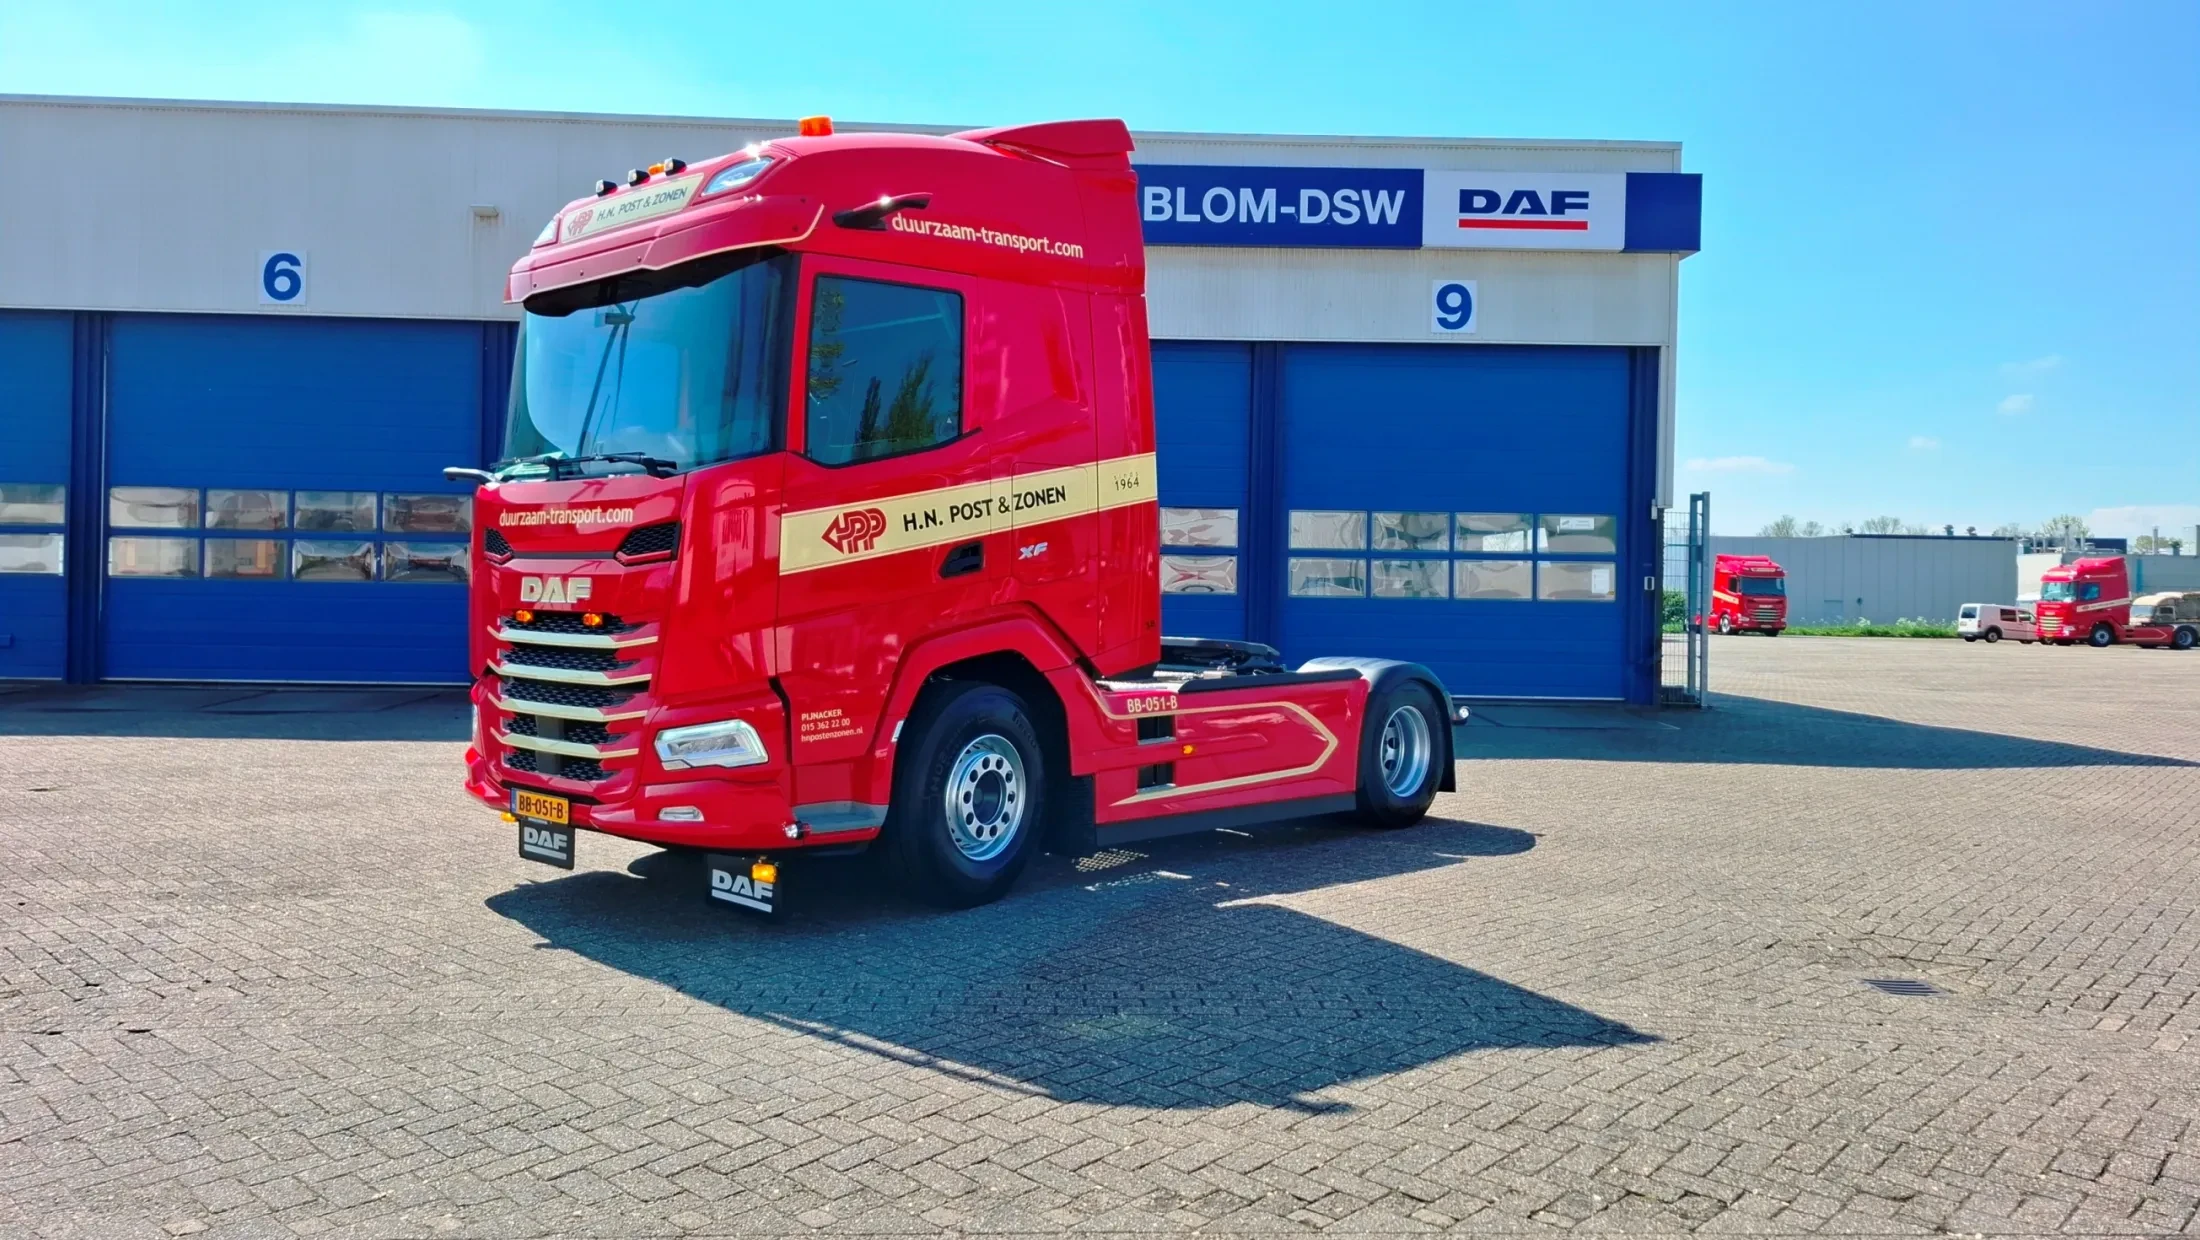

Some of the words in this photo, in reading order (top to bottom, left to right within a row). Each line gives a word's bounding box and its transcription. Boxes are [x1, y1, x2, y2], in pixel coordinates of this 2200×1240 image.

[596, 207, 615, 221] H.N.
[618, 199, 644, 214] POST
[643, 197, 651, 208] &
[652, 187, 688, 205] ZONEN
[1143, 186, 1405, 225] BLOM-DSW
[1459, 189, 1590, 215] DAF
[891, 212, 1084, 259] duurzaam-transport.com
[263, 252, 302, 301] 6
[1436, 283, 1472, 330] 9
[1115, 477, 1139, 491] 1964
[499, 506, 633, 527] duurzaam-transport.com
[903, 509, 943, 532] H.N.
[950, 499, 993, 523] POST
[998, 496, 1010, 514] &
[1013, 485, 1066, 511] ZONEN
[1018, 541, 1048, 561] XF
[520, 576, 592, 604] DAF
[801, 709, 842, 721] PIJNACKER
[1127, 695, 1178, 713] BB-051-B
[801, 723, 815, 732] 015
[816, 720, 830, 730] 362
[831, 719, 840, 728] 22
[841, 718, 851, 726] 00
[801, 726, 863, 742] hnpostenzonen.nl
[518, 794, 564, 820] BB-051-B
[523, 826, 568, 850] DAF
[712, 868, 774, 900] DAF
